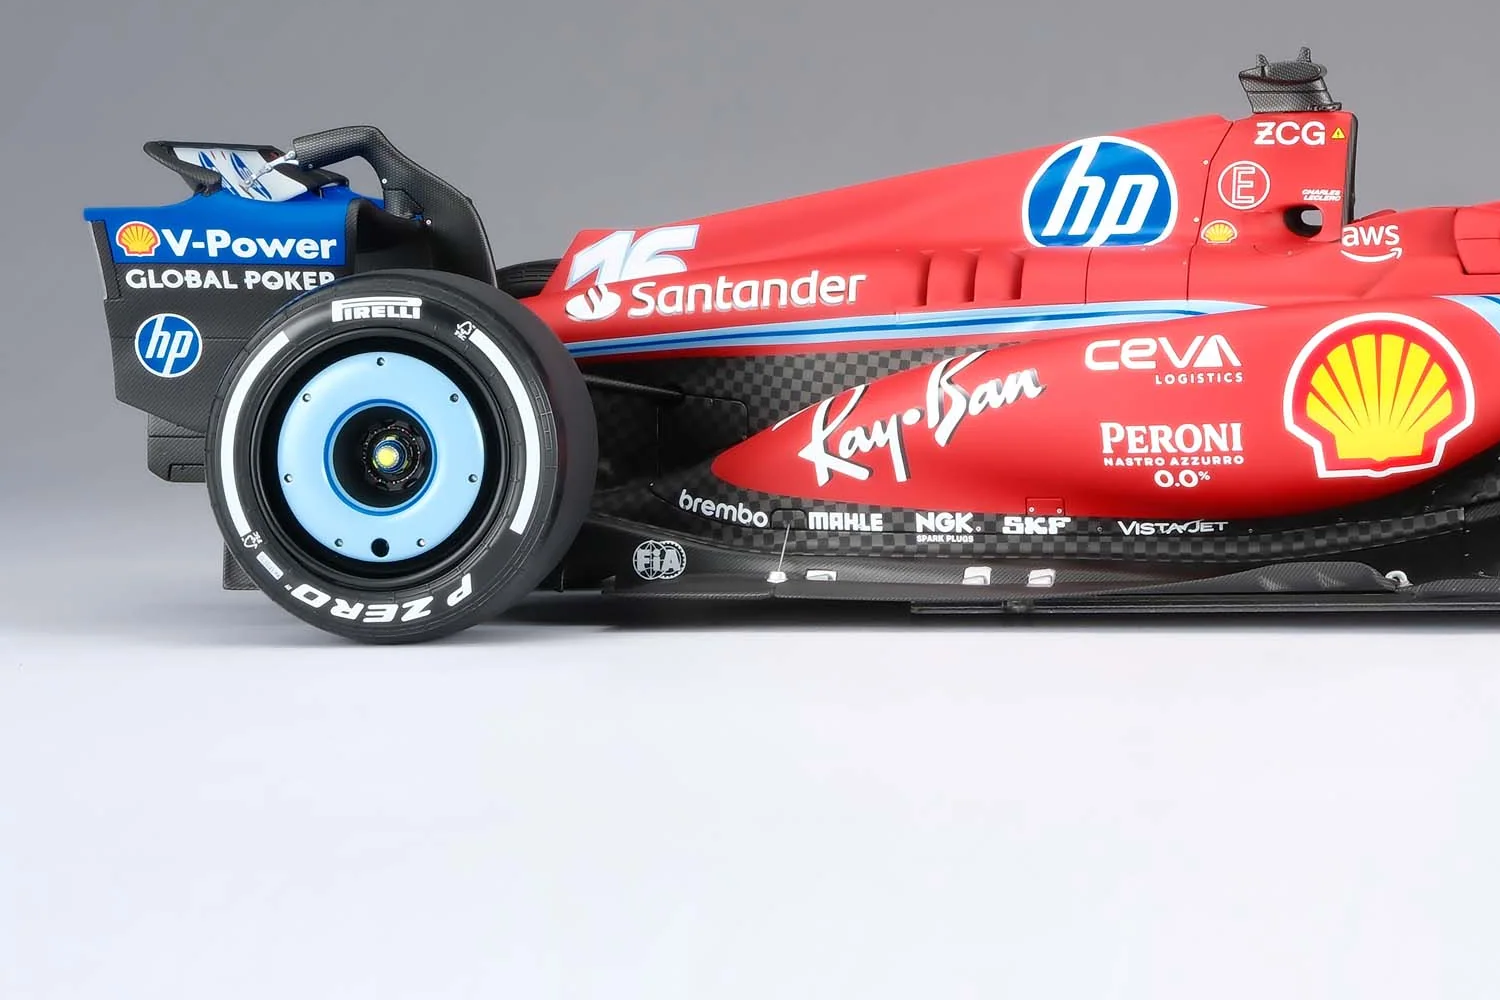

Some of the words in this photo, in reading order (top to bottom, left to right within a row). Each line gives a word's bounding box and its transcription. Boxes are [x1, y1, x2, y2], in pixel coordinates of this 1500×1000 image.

[1254, 121, 1326, 146] ZCG
[1040, 139, 1159, 248] hp
[161, 229, 337, 259] V-Power
[1342, 224, 1400, 248] aws
[125, 269, 238, 290] GLOBAL
[628, 269, 867, 318] Santander
[332, 296, 422, 322] PIRELLI
[145, 314, 195, 377] hp
[1155, 372, 1243, 385] LOGISTICS
[1100, 422, 1244, 454] PERONI
[1104, 457, 1165, 467] NASTRO
[1170, 455, 1244, 466] AZZURRO
[1154, 469, 1211, 488] 0.0%
[679, 488, 768, 528] brembo
[808, 511, 883, 532] MAHLE
[916, 512, 974, 533] NGK
[1002, 516, 1071, 535] SKF
[916, 535, 944, 543] SPARK
[946, 535, 974, 543] PLUGS
[447, 573, 473, 607] P
[290, 583, 434, 623] ZERO
